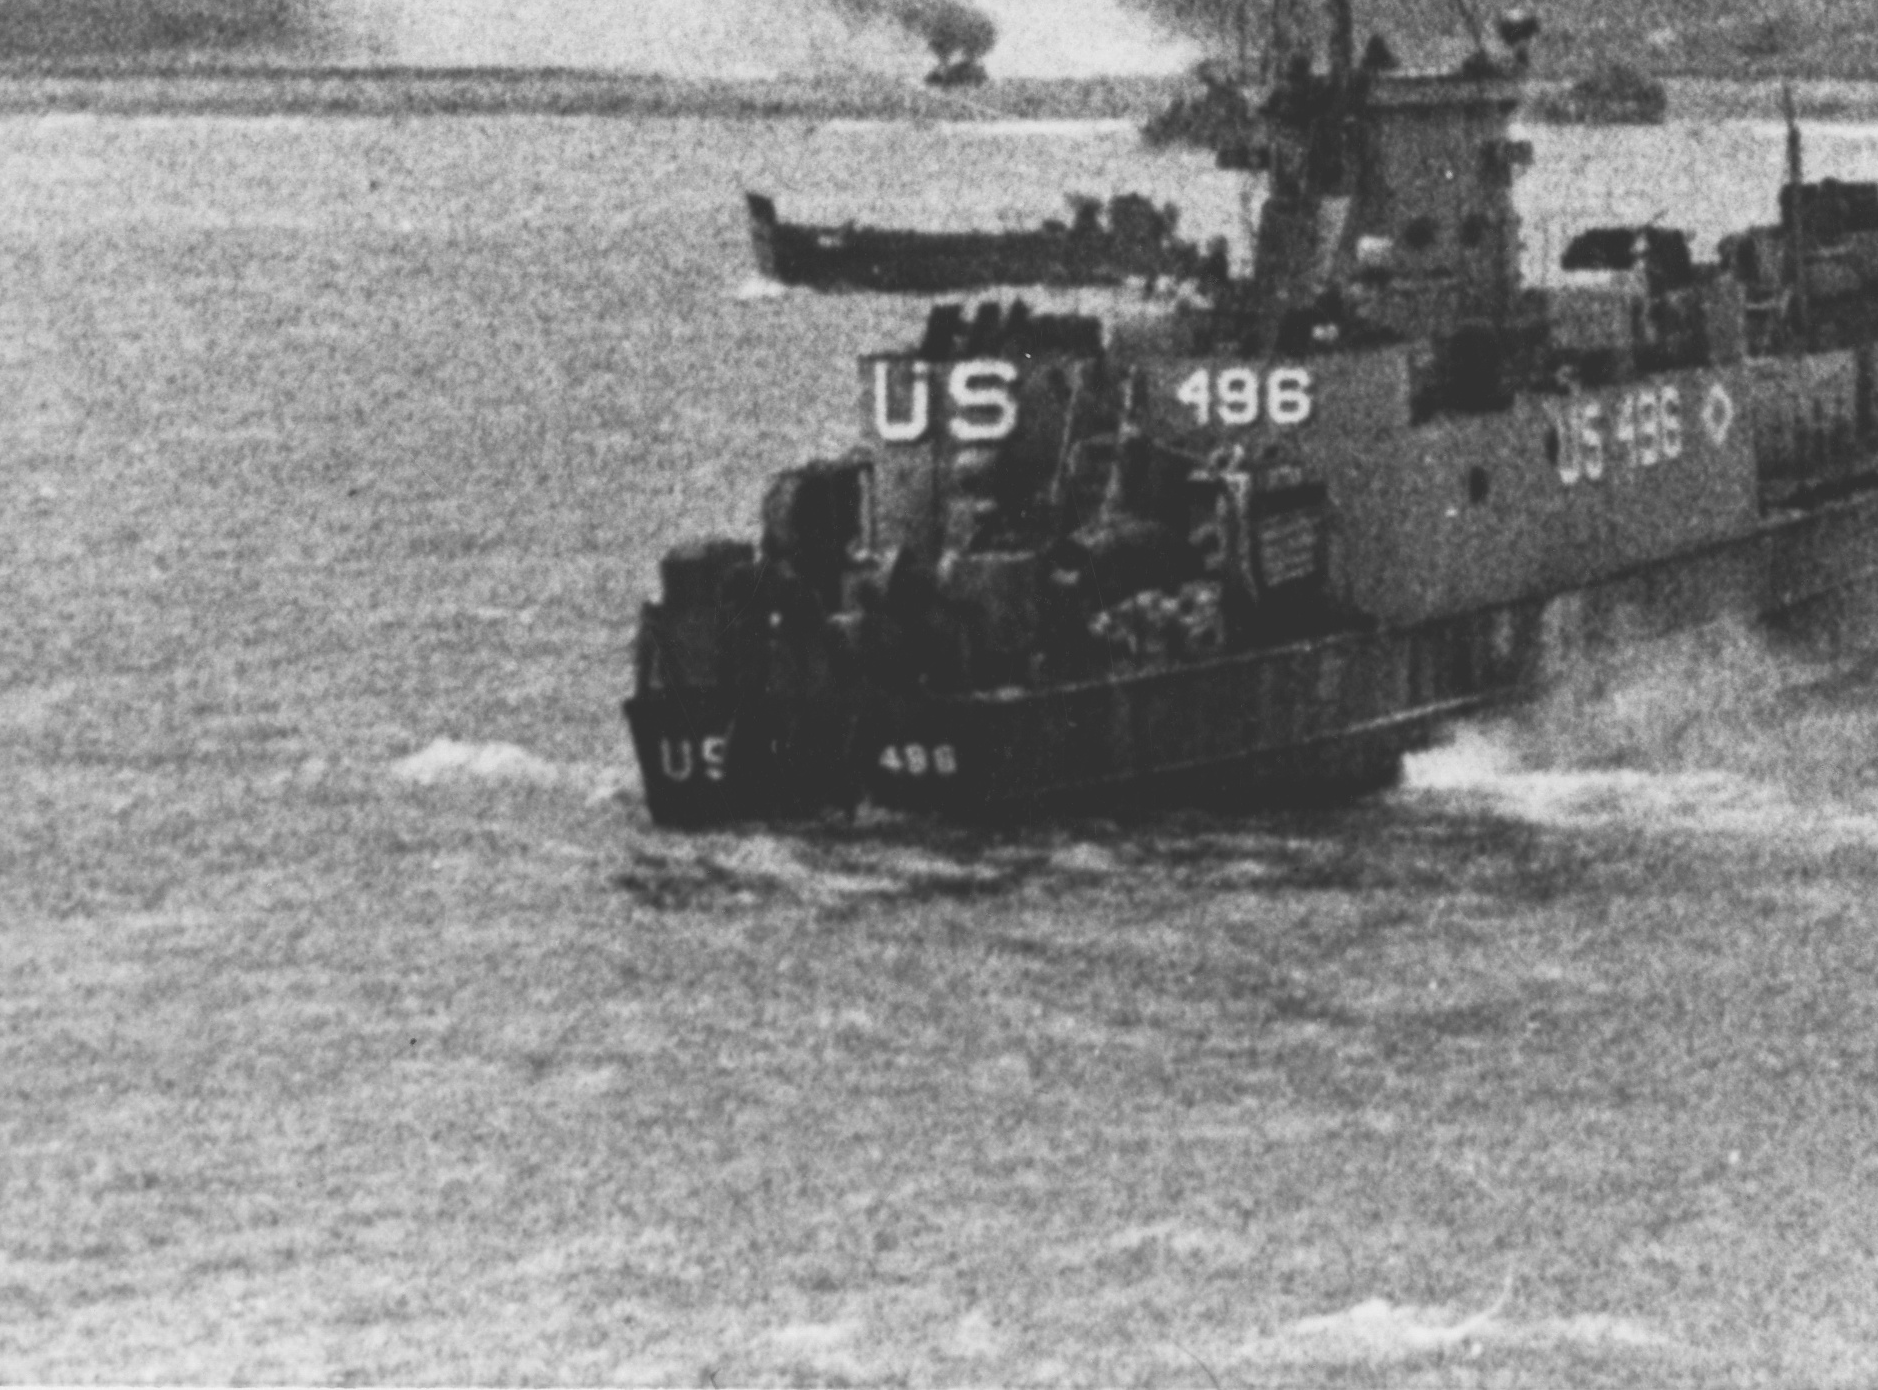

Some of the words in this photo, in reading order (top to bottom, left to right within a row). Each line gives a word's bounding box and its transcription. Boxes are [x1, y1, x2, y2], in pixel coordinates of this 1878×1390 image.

[874, 358, 1018, 441] US
[1176, 367, 1312, 425] 496
[1549, 401, 1603, 485] US
[1617, 385, 1682, 468] 496
